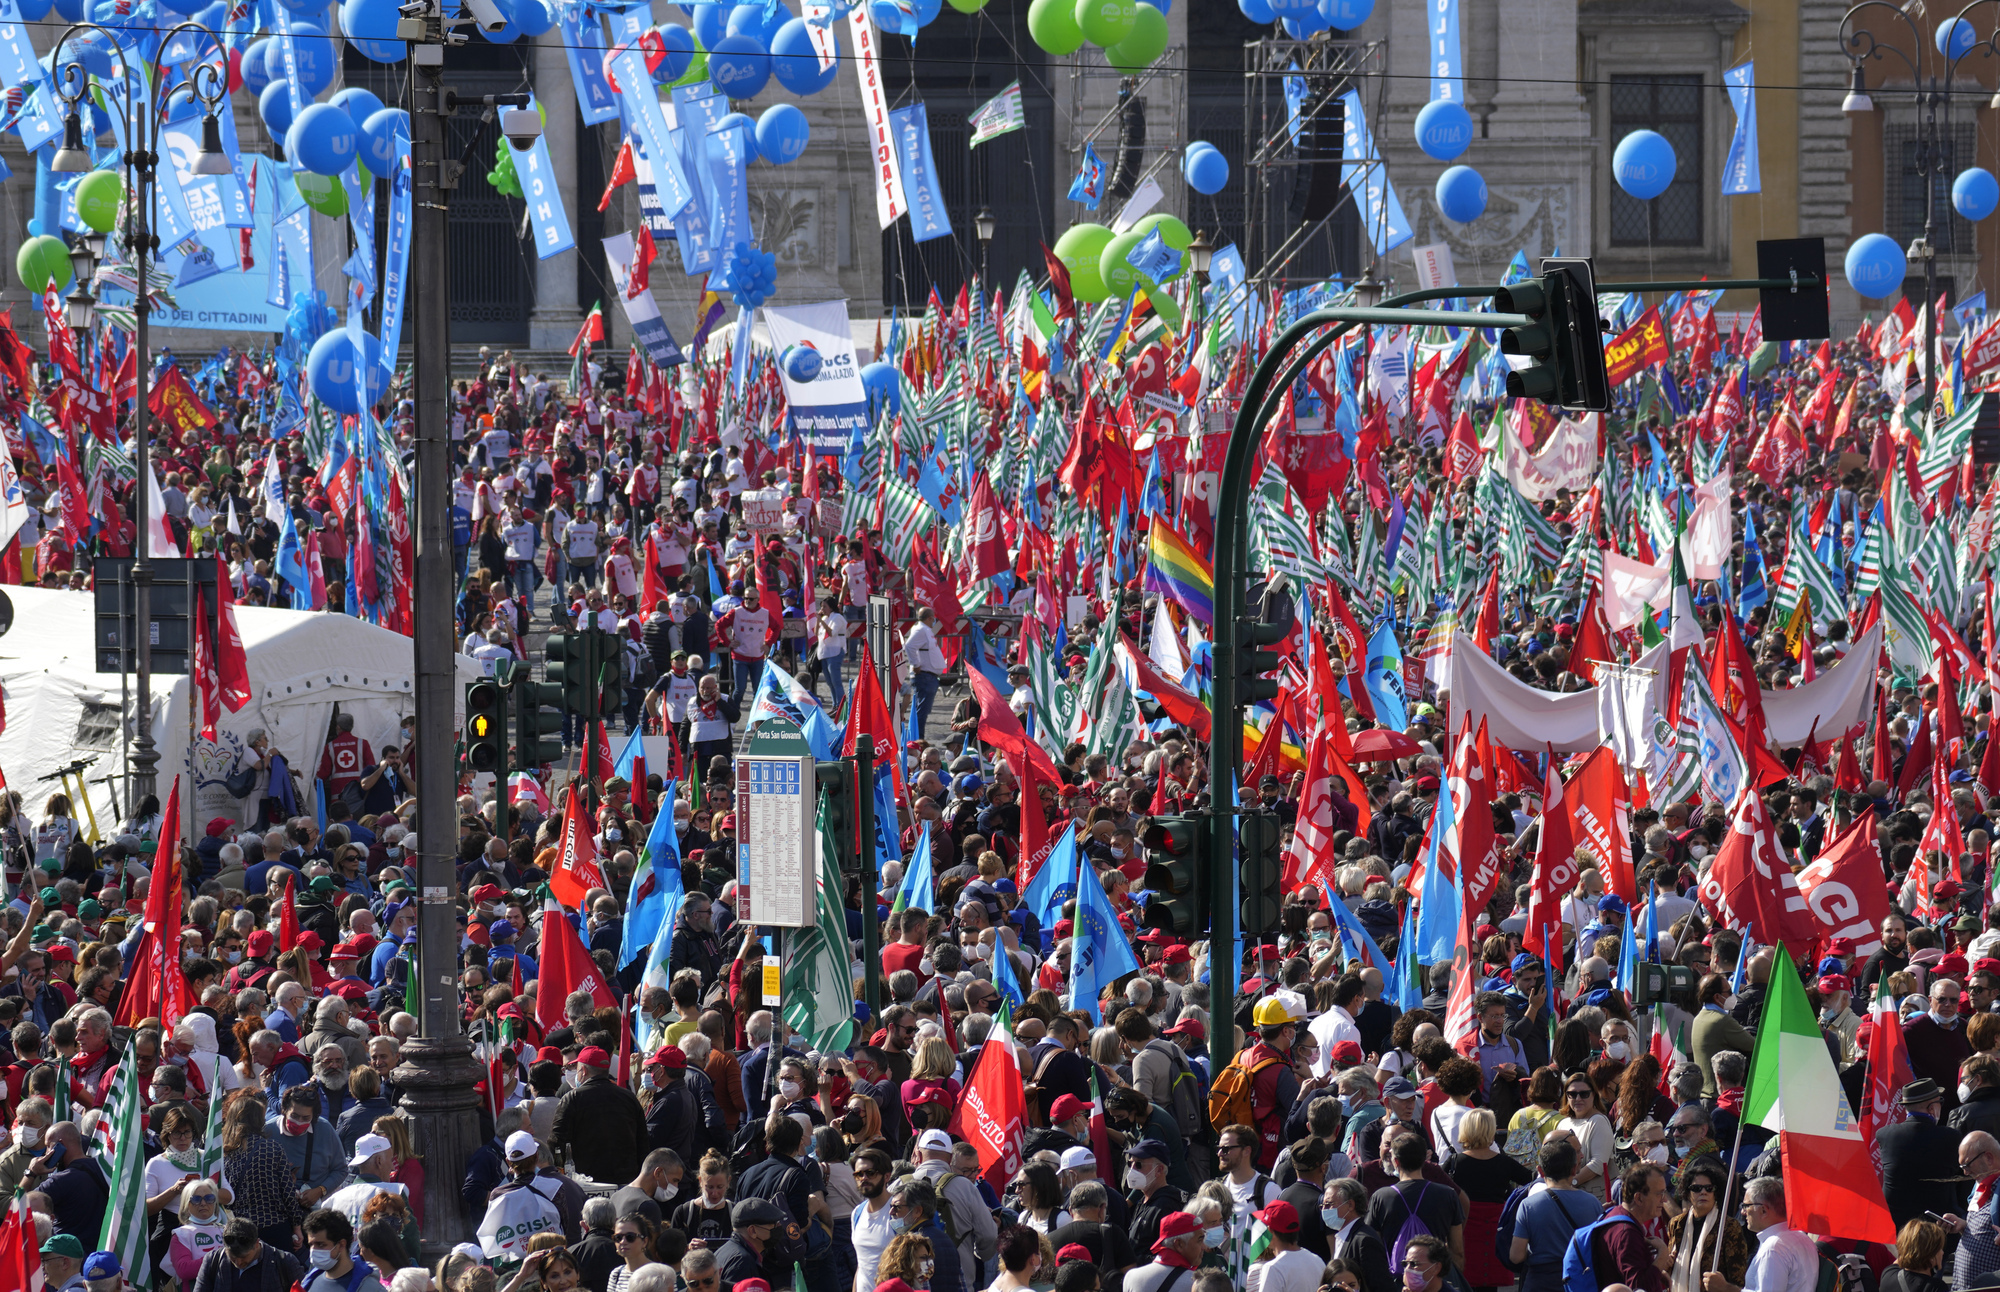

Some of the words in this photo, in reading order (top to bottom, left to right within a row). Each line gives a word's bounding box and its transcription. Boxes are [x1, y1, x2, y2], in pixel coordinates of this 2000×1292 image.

[171, 310, 193, 321] DEI
[197, 311, 267, 324] CITTADINI
[328, 360, 380, 388] UL
[835, 369, 855, 380] LAZIO
[1145, 395, 1182, 412] PORDENONE
[180, 398, 206, 427] FIOM
[835, 412, 859, 429] Lavortori
[744, 510, 783, 525] FASCISTA
[757, 730, 770, 740] Porta
[771, 731, 780, 740] San
[781, 730, 802, 740] Giovanni
[751, 784, 758, 793] 16
[763, 784, 769, 793] 81
[775, 784, 782, 793] 85
[787, 784, 795, 793] 87
[1577, 836, 1616, 895] MANTOV
[1795, 857, 1886, 958] CGIL
[514, 1215, 554, 1236] CISL
[196, 1236, 211, 1244] FNP
[497, 1228, 513, 1242] FNP
